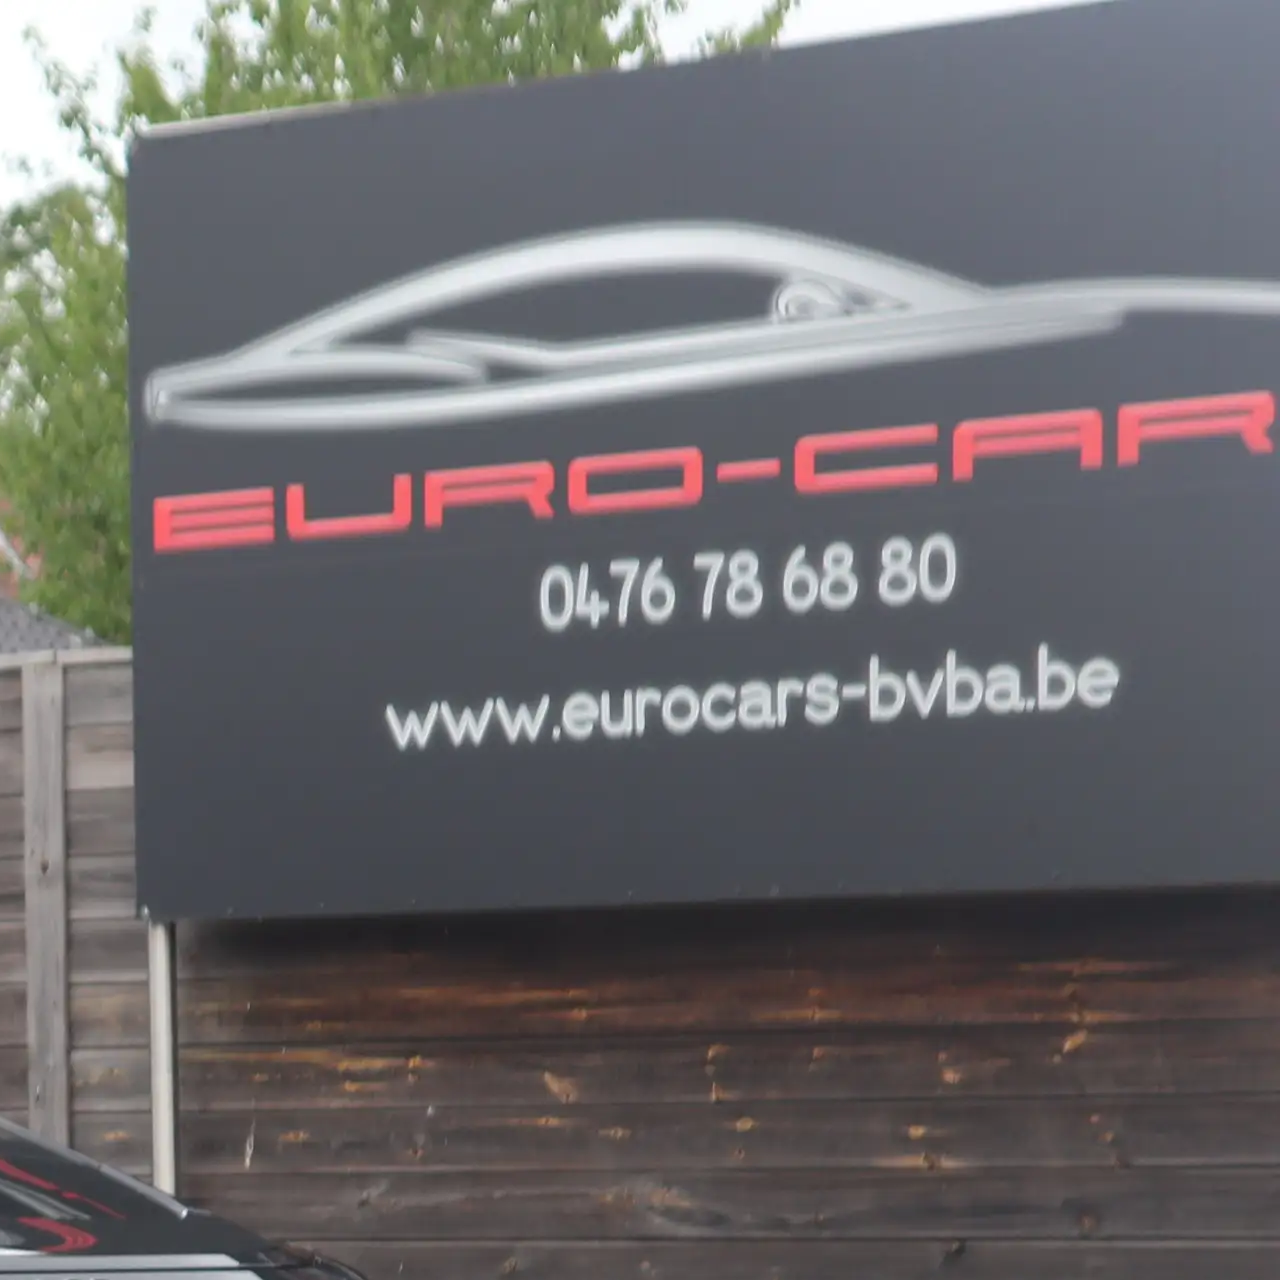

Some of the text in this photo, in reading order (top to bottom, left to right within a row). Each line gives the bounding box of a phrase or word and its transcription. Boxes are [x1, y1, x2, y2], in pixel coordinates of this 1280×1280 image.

[539, 532, 958, 632] 0476 78 68 80
[384, 642, 1121, 750] www.eurocars-bvba.be
